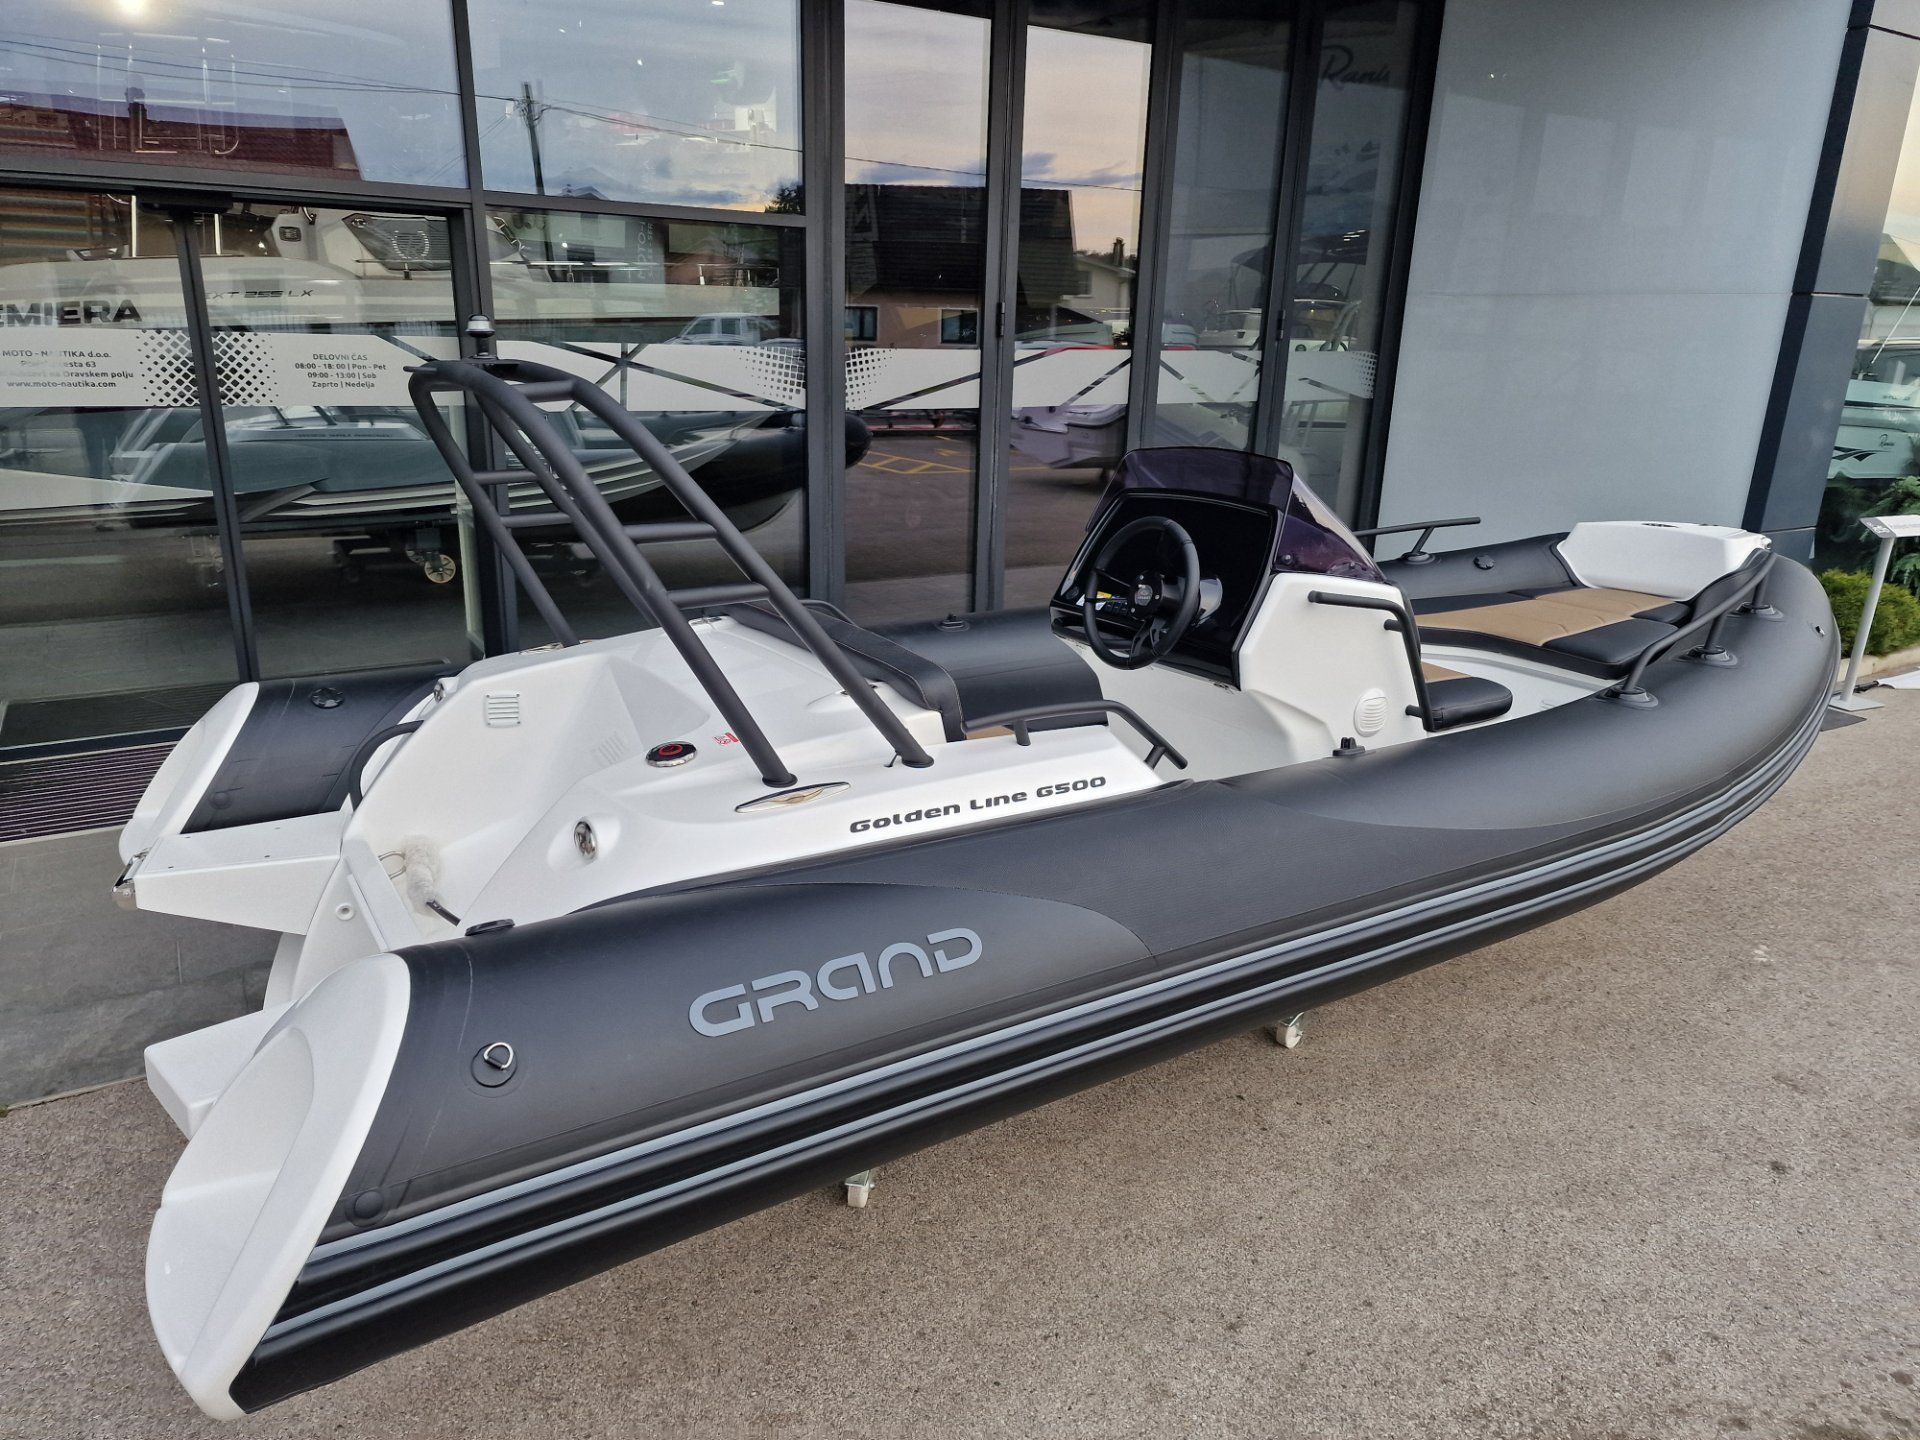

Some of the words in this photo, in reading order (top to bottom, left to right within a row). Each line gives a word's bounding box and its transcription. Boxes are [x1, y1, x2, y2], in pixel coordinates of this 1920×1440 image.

[0, 299, 142, 328] MIERA
[41, 350, 86, 358] NTIKA
[87, 350, 112, 358] d.o.o.
[312, 353, 349, 361] DELOVNI
[351, 352, 368, 361] ČAS
[110, 371, 134, 380] polju
[312, 381, 339, 389] Zaprto
[345, 381, 375, 389] Nedelja
[850, 802, 960, 833] Golden
[970, 791, 1028, 811] Line
[1036, 776, 1106, 798] G500
[688, 927, 984, 1038] GRAND
